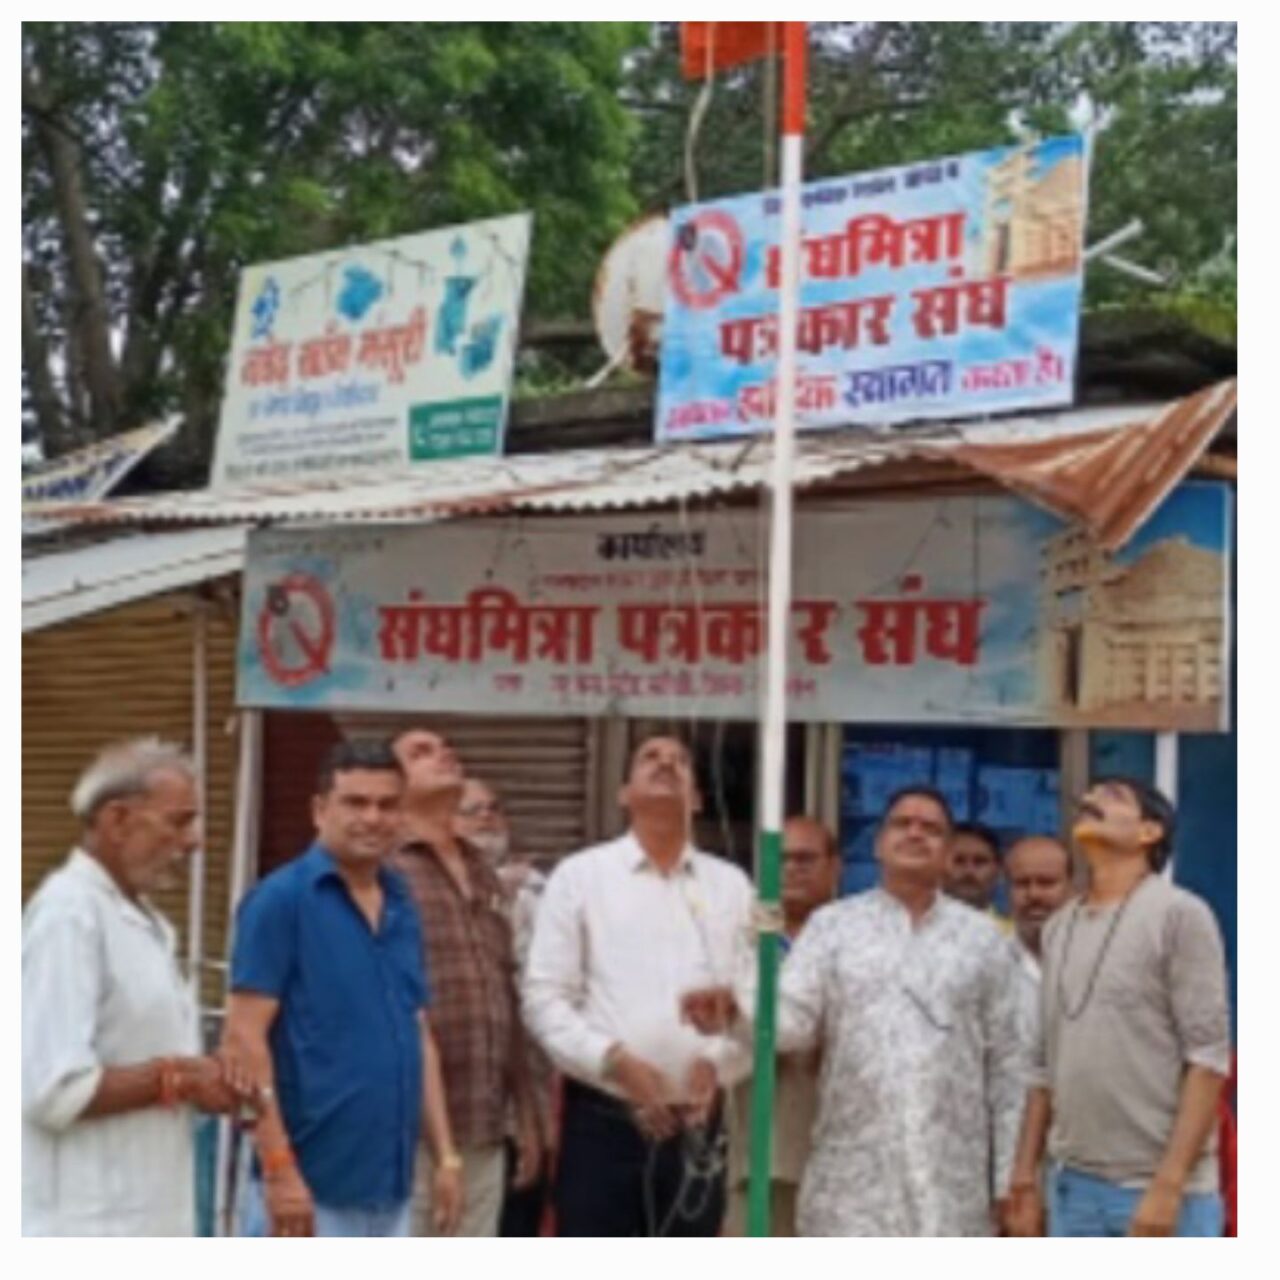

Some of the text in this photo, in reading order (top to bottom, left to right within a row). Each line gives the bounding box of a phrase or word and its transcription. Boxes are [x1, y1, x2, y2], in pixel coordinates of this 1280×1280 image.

[911, 265, 1011, 340] संघ
[844, 359, 953, 407] स्वागत
[377, 575, 988, 665] संघमित्रा पत्रकर संघ
